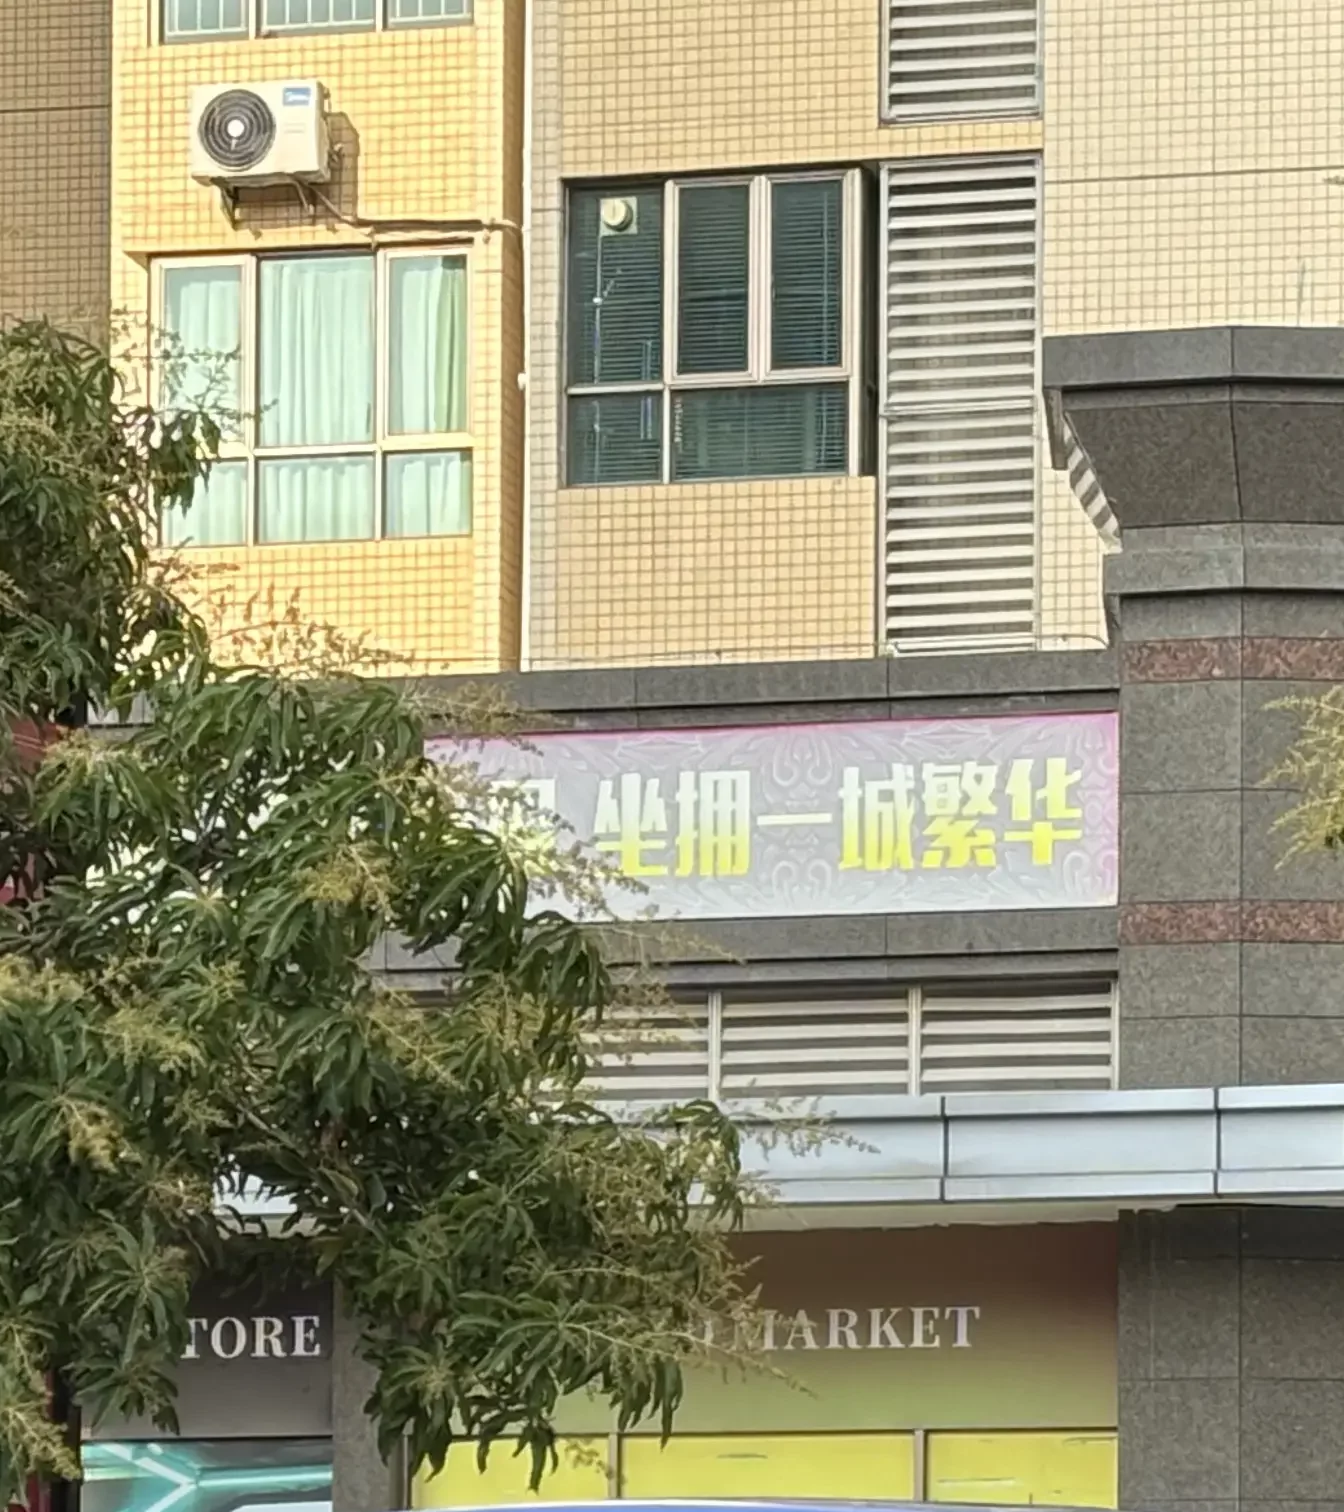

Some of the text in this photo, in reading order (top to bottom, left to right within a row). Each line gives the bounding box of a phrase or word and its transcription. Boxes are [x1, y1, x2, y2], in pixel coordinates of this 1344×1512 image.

[593, 757, 1083, 877] 坐拥一城繁华
